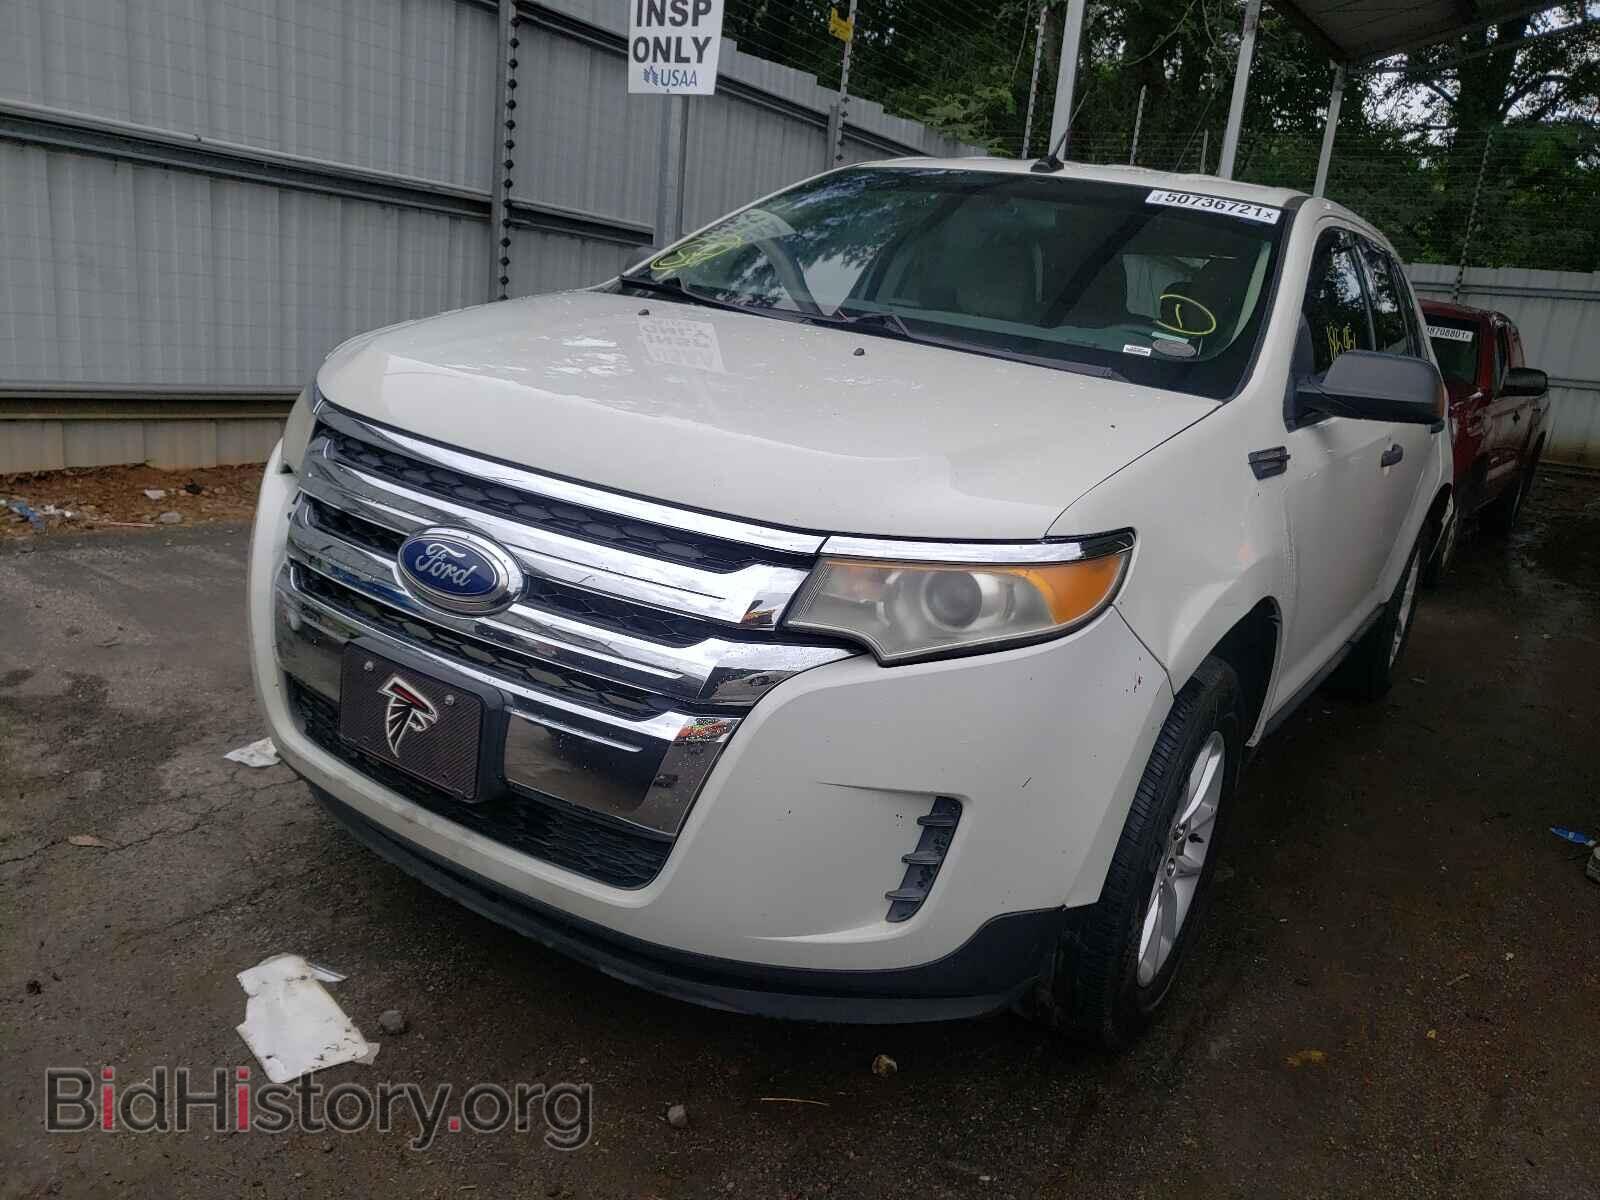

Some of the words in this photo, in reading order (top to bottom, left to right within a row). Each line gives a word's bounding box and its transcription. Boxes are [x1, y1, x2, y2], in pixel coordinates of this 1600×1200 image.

[635, 0, 712, 28] INSP
[632, 36, 713, 64] ONLY
[660, 68, 698, 87] USAA
[415, 543, 478, 587] Ford
